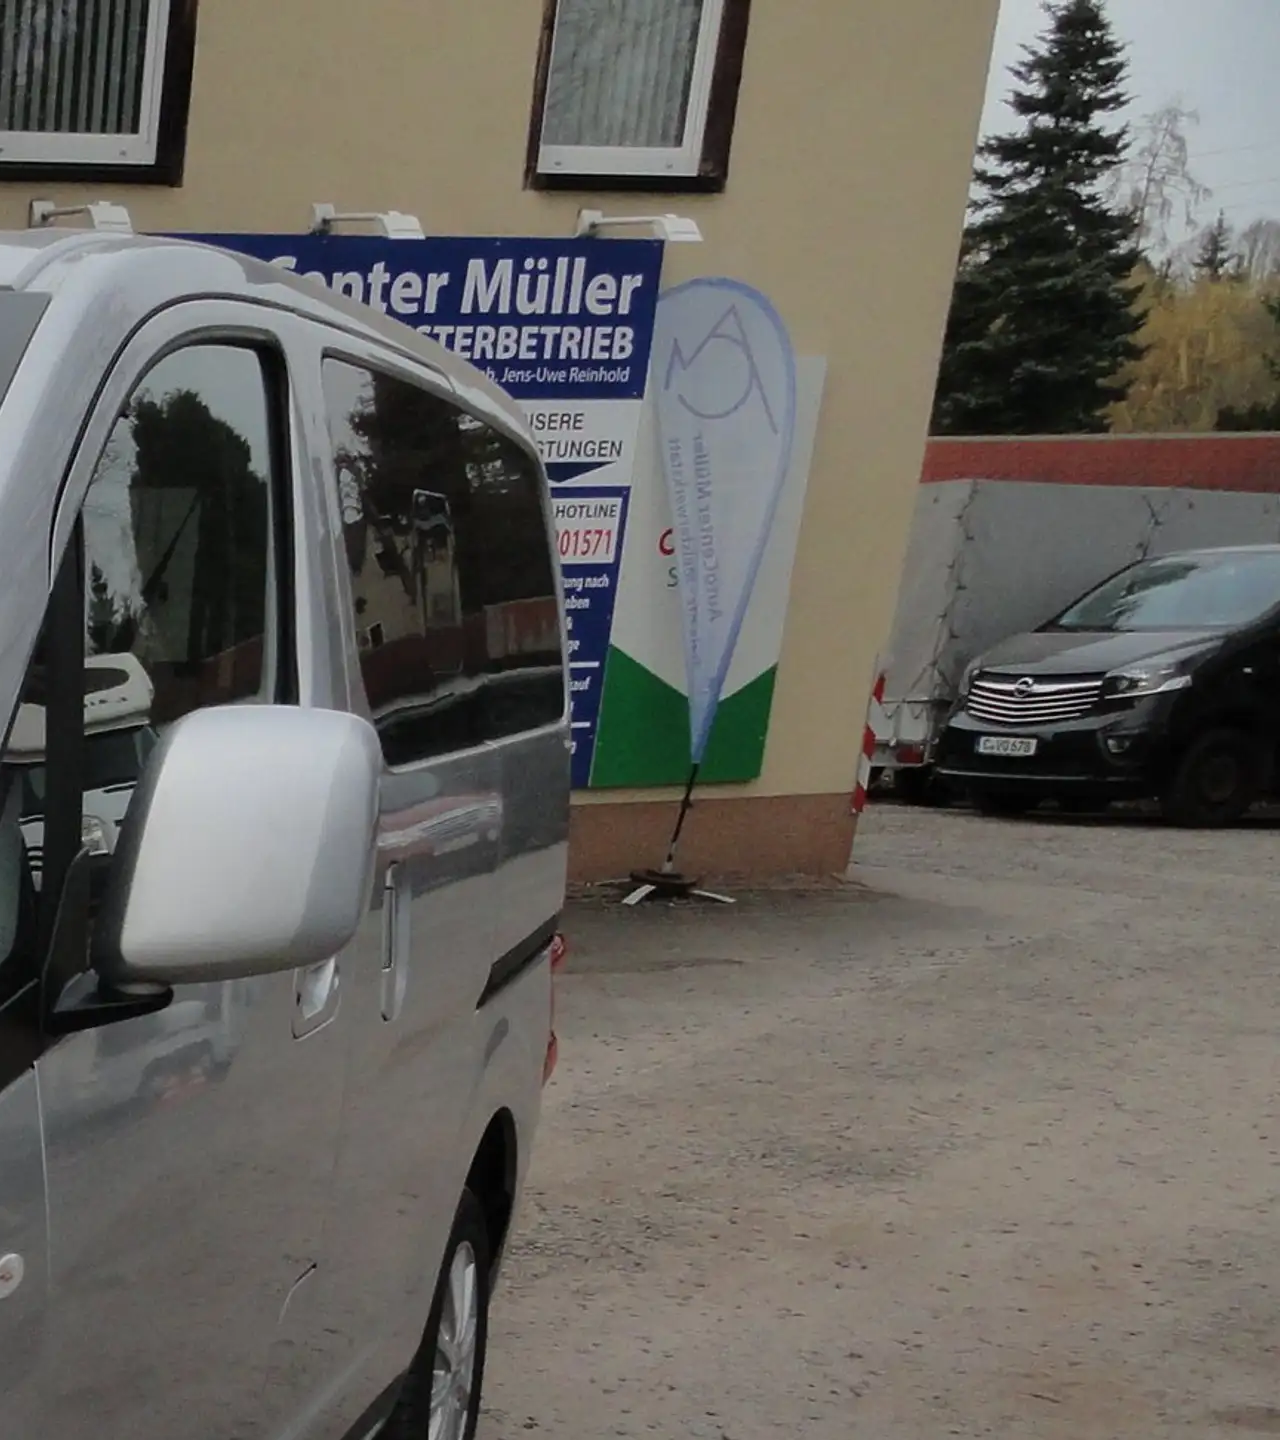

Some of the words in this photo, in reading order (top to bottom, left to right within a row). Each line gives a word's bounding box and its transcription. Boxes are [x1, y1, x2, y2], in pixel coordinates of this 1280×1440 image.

[459, 256, 644, 316] Müller
[500, 367, 567, 385] Jens-Uwe
[568, 366, 631, 384] Reinhold
[555, 503, 618, 519] HOTLINE
[556, 529, 612, 556] 01571
